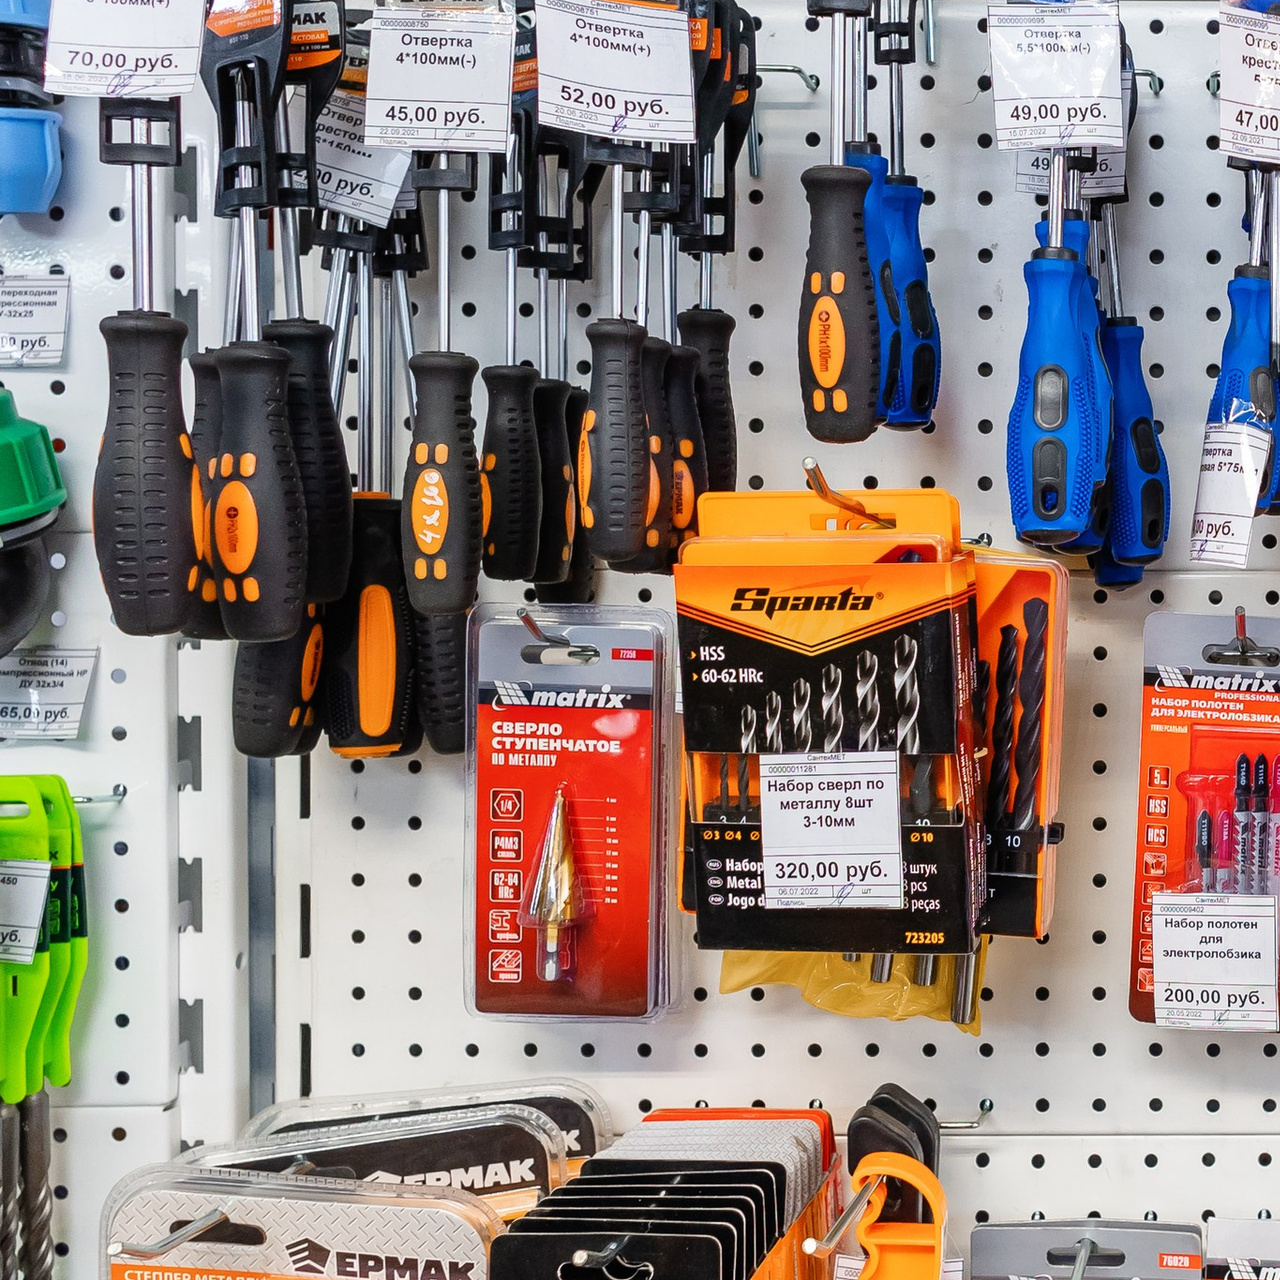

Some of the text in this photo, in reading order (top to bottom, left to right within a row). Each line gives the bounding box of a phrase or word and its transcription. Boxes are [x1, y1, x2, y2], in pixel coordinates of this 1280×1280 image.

[575, 18, 644, 40] Отвертка
[401, 34, 473, 49] Отвертка
[68, 50, 179, 74] 70,00 руб.
[560, 85, 670, 119] 52,00 руб.
[1235, 108, 1279, 131] 47,00
[730, 587, 875, 615] Sparta
[700, 646, 725, 661] HSS
[1189, 671, 1278, 693] matrix
[1151, 698, 1244, 711] НАБОР ПОЛОТЕН
[1151, 708, 1280, 723] ДЛЯ ЭЛЕКТРОЛОБЗИКА
[491, 721, 562, 736] СВЕРЛО
[491, 737, 620, 753] СТУПЕНЧАТОЕ
[767, 778, 885, 793] Набор сверл по
[779, 797, 874, 811] металлу 8шт
[802, 815, 856, 828] 3-10мм
[774, 861, 889, 882] 320,00 руб.
[1163, 946, 1261, 960] электролобзика
[1164, 989, 1265, 1007] 200,00 руб.
